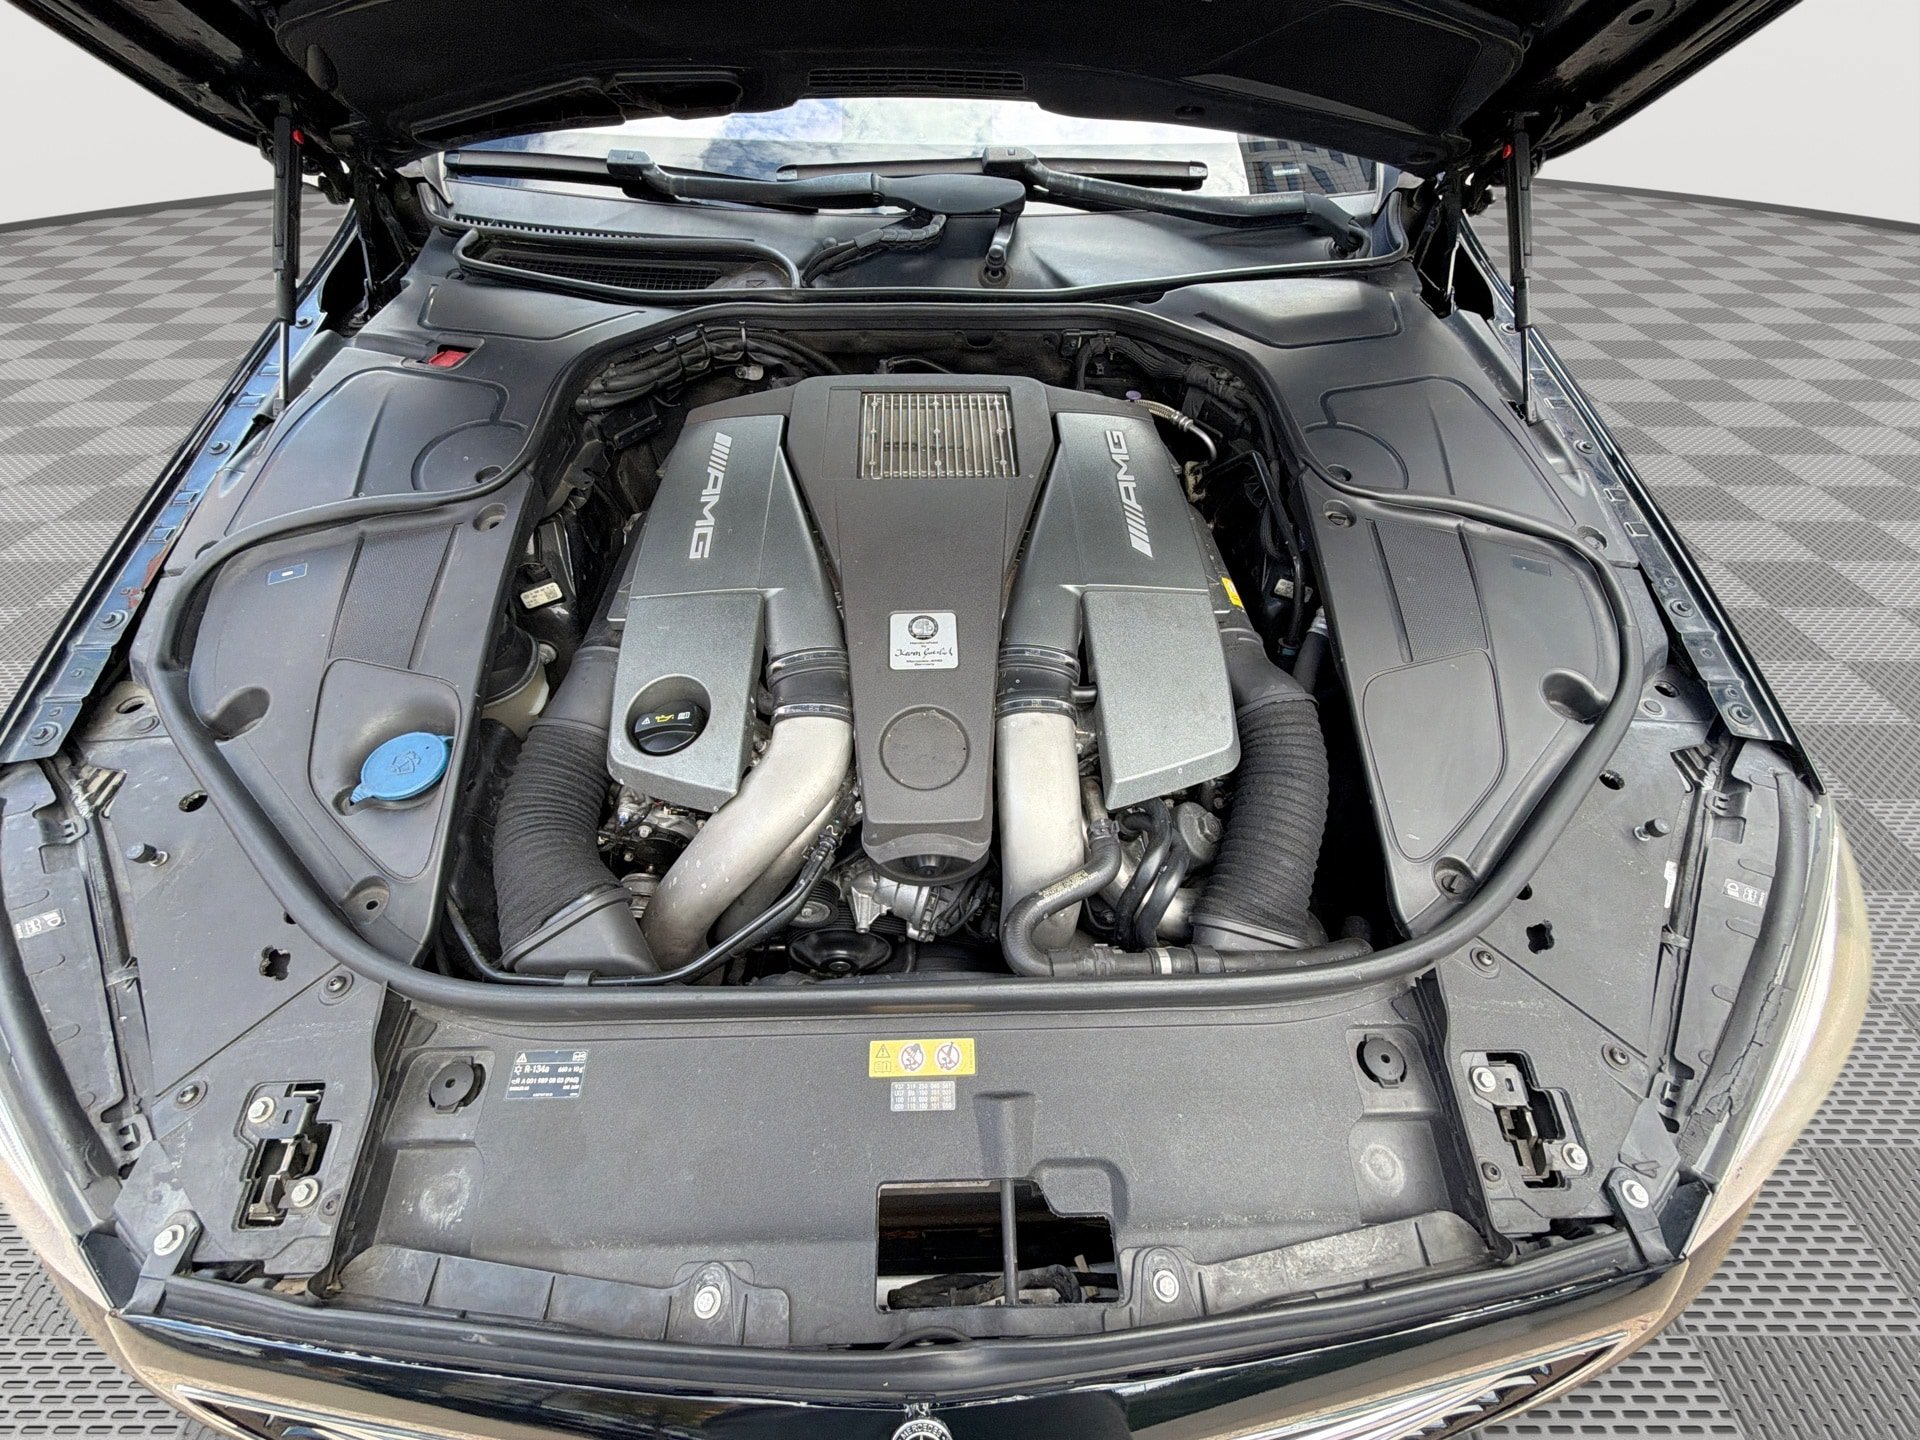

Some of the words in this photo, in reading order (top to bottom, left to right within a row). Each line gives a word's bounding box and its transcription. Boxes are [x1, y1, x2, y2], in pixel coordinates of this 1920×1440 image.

[688, 465, 725, 559] AMG
[523, 1065, 550, 1073] R-134a
[900, 1423, 943, 1440] MERCEDES
